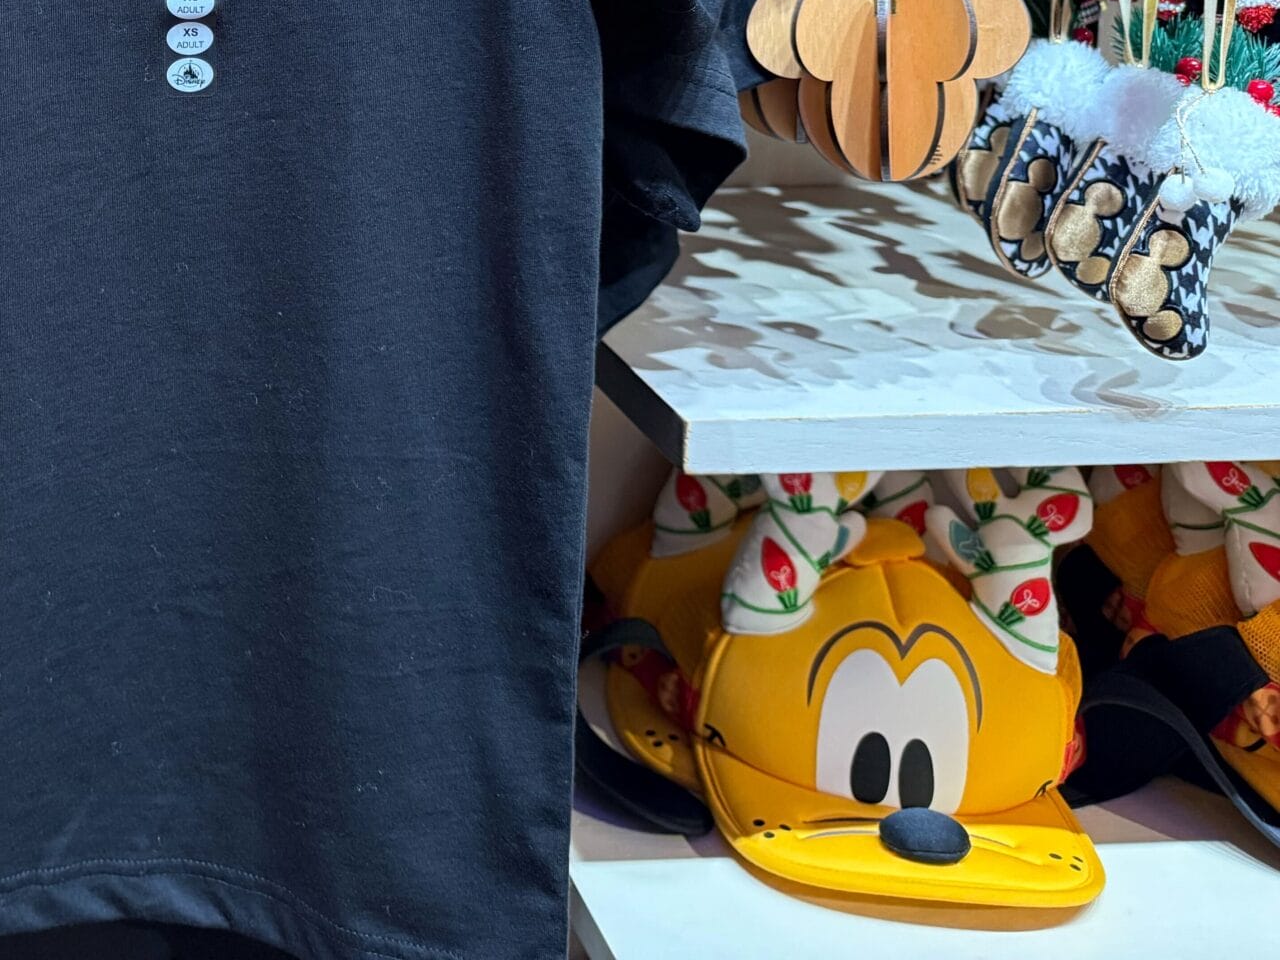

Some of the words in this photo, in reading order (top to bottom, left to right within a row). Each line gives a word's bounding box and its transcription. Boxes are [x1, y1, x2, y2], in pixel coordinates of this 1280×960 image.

[177, 6, 205, 14] ADULT
[183, 28, 199, 37] XS
[176, 41, 204, 49] ADULT
